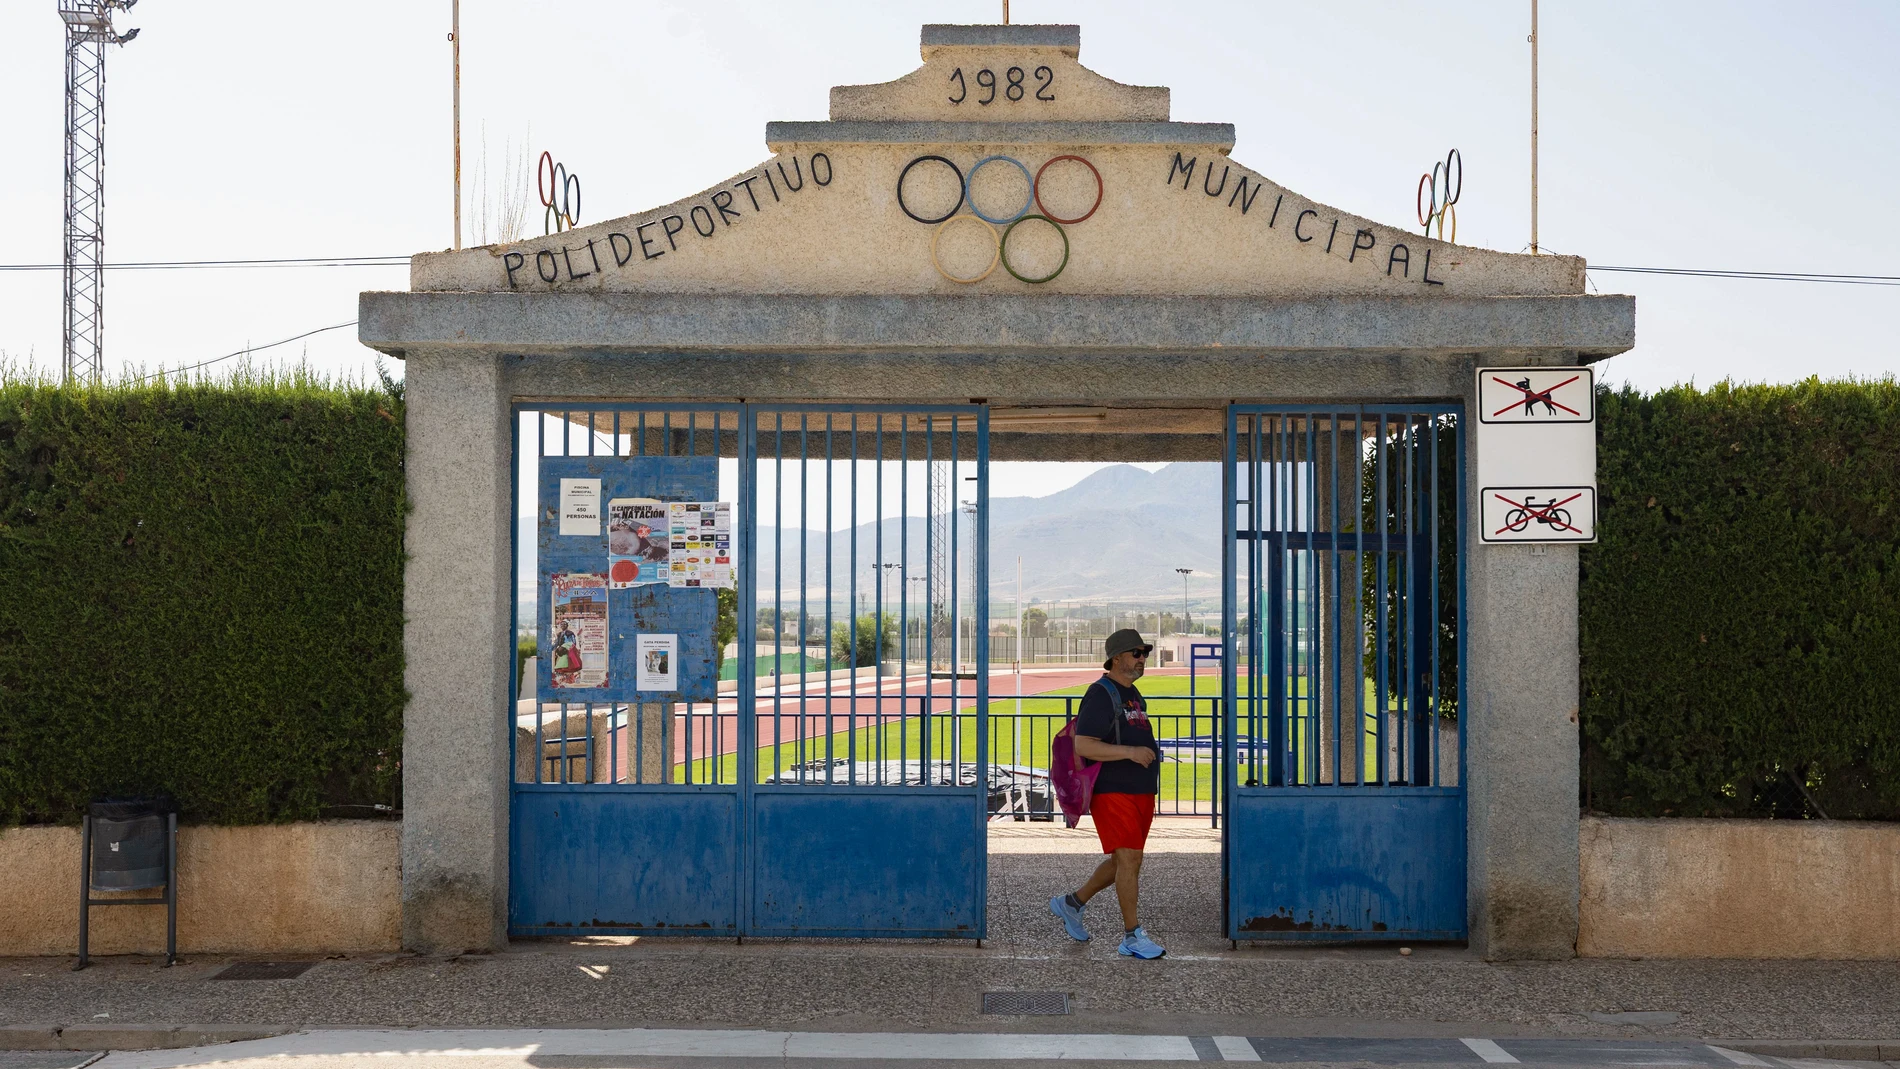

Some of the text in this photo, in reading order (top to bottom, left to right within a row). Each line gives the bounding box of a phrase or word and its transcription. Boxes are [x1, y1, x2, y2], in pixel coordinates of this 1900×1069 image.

[948, 65, 1056, 106] 1982
[1167, 151, 1444, 286] MUNICIPAL
[622, 508, 665, 519] NATACIÓN
